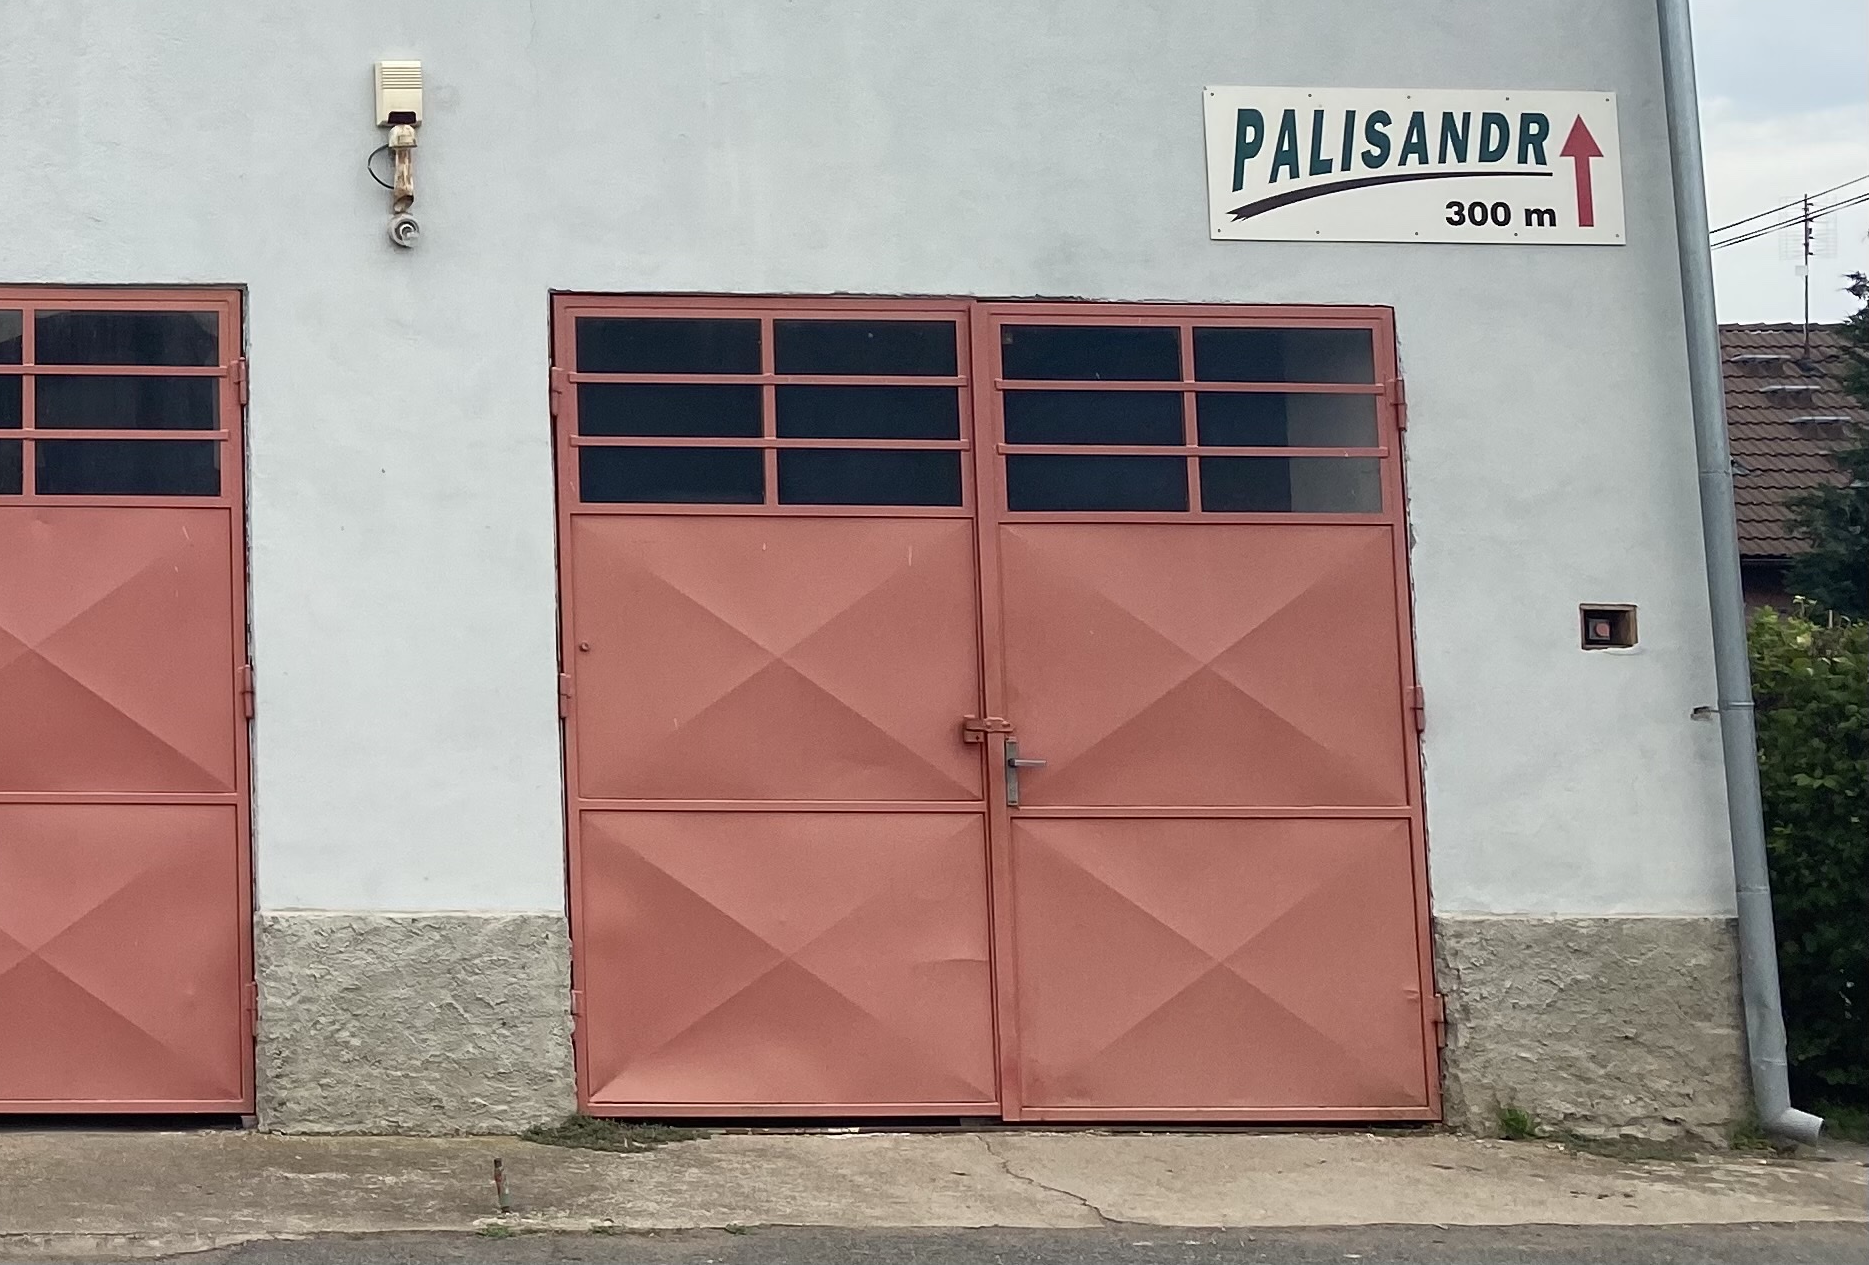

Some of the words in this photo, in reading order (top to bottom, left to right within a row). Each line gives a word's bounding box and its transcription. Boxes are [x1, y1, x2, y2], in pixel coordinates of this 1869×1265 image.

[1232, 108, 1550, 192] PALISANDR
[1445, 201, 1512, 227] 300
[1524, 207, 1557, 227] m
